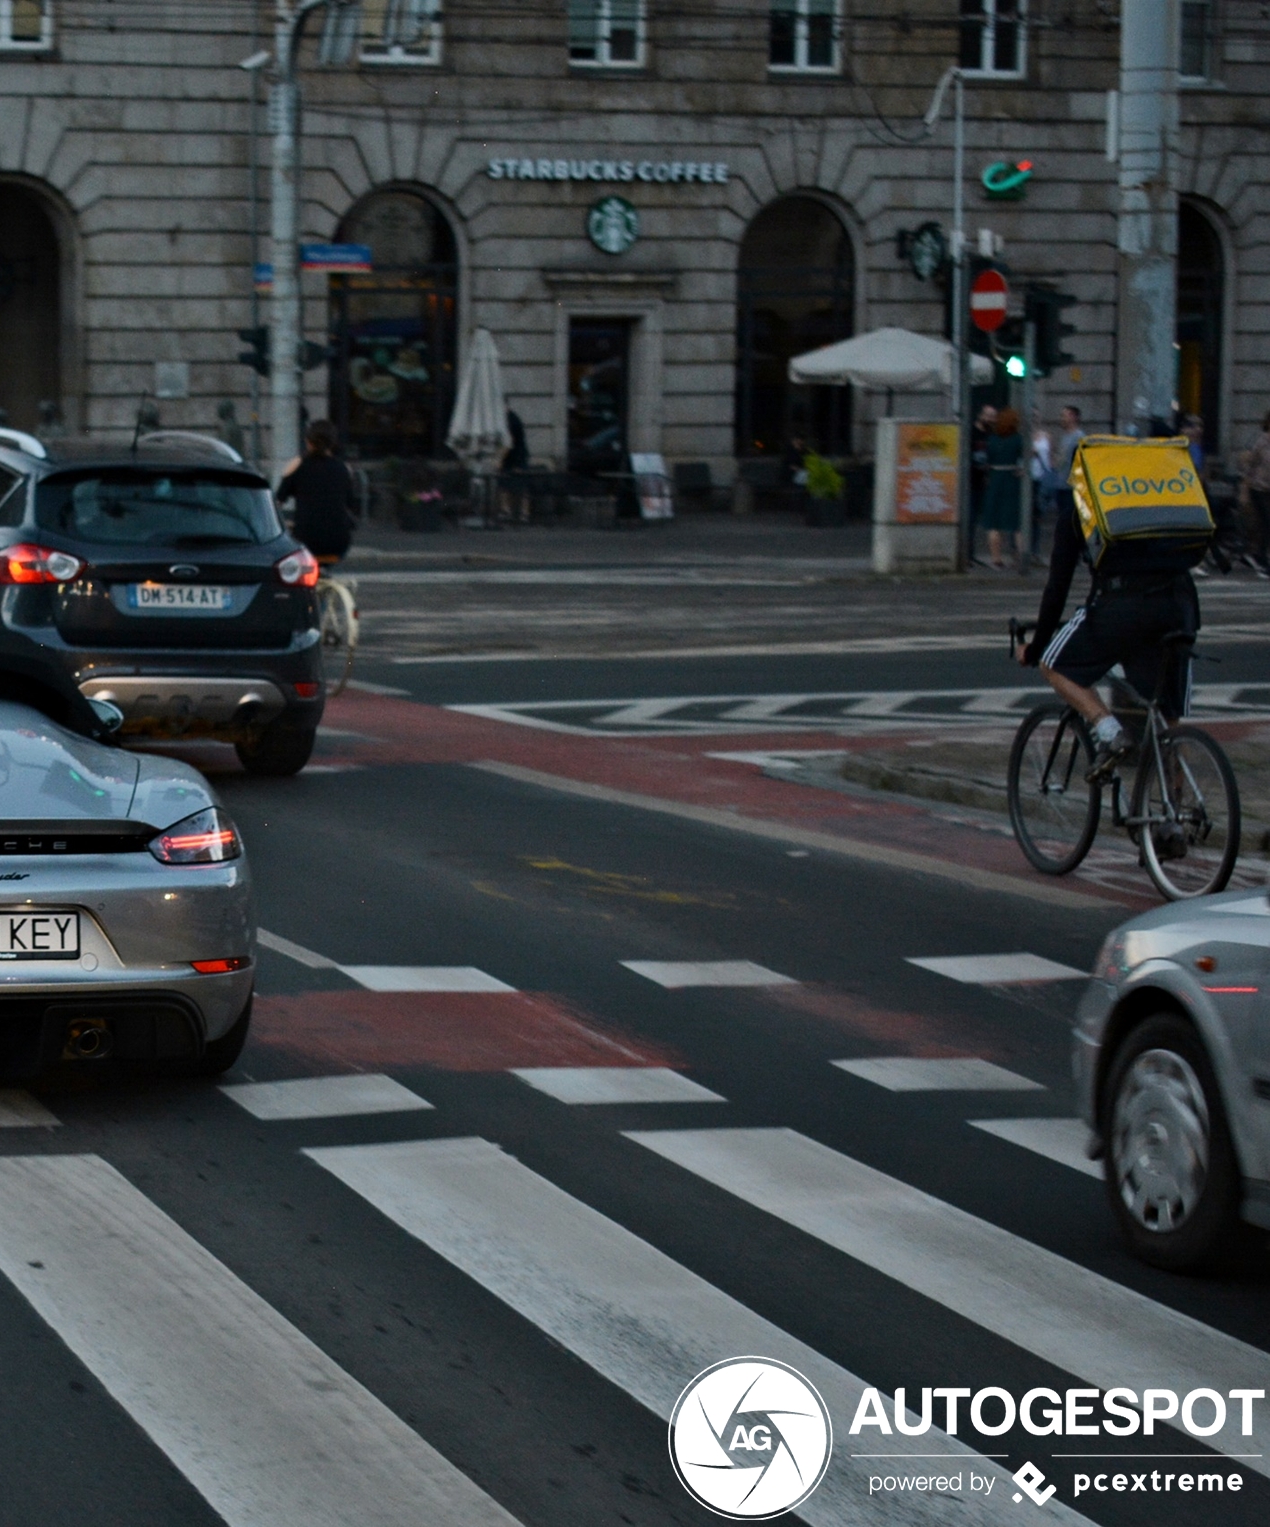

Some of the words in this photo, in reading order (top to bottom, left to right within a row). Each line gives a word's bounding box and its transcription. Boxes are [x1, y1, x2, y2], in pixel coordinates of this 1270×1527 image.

[487, 158, 634, 182] STARBUCKS
[636, 161, 728, 184] COFFEE
[1099, 475, 1186, 496] Glovo
